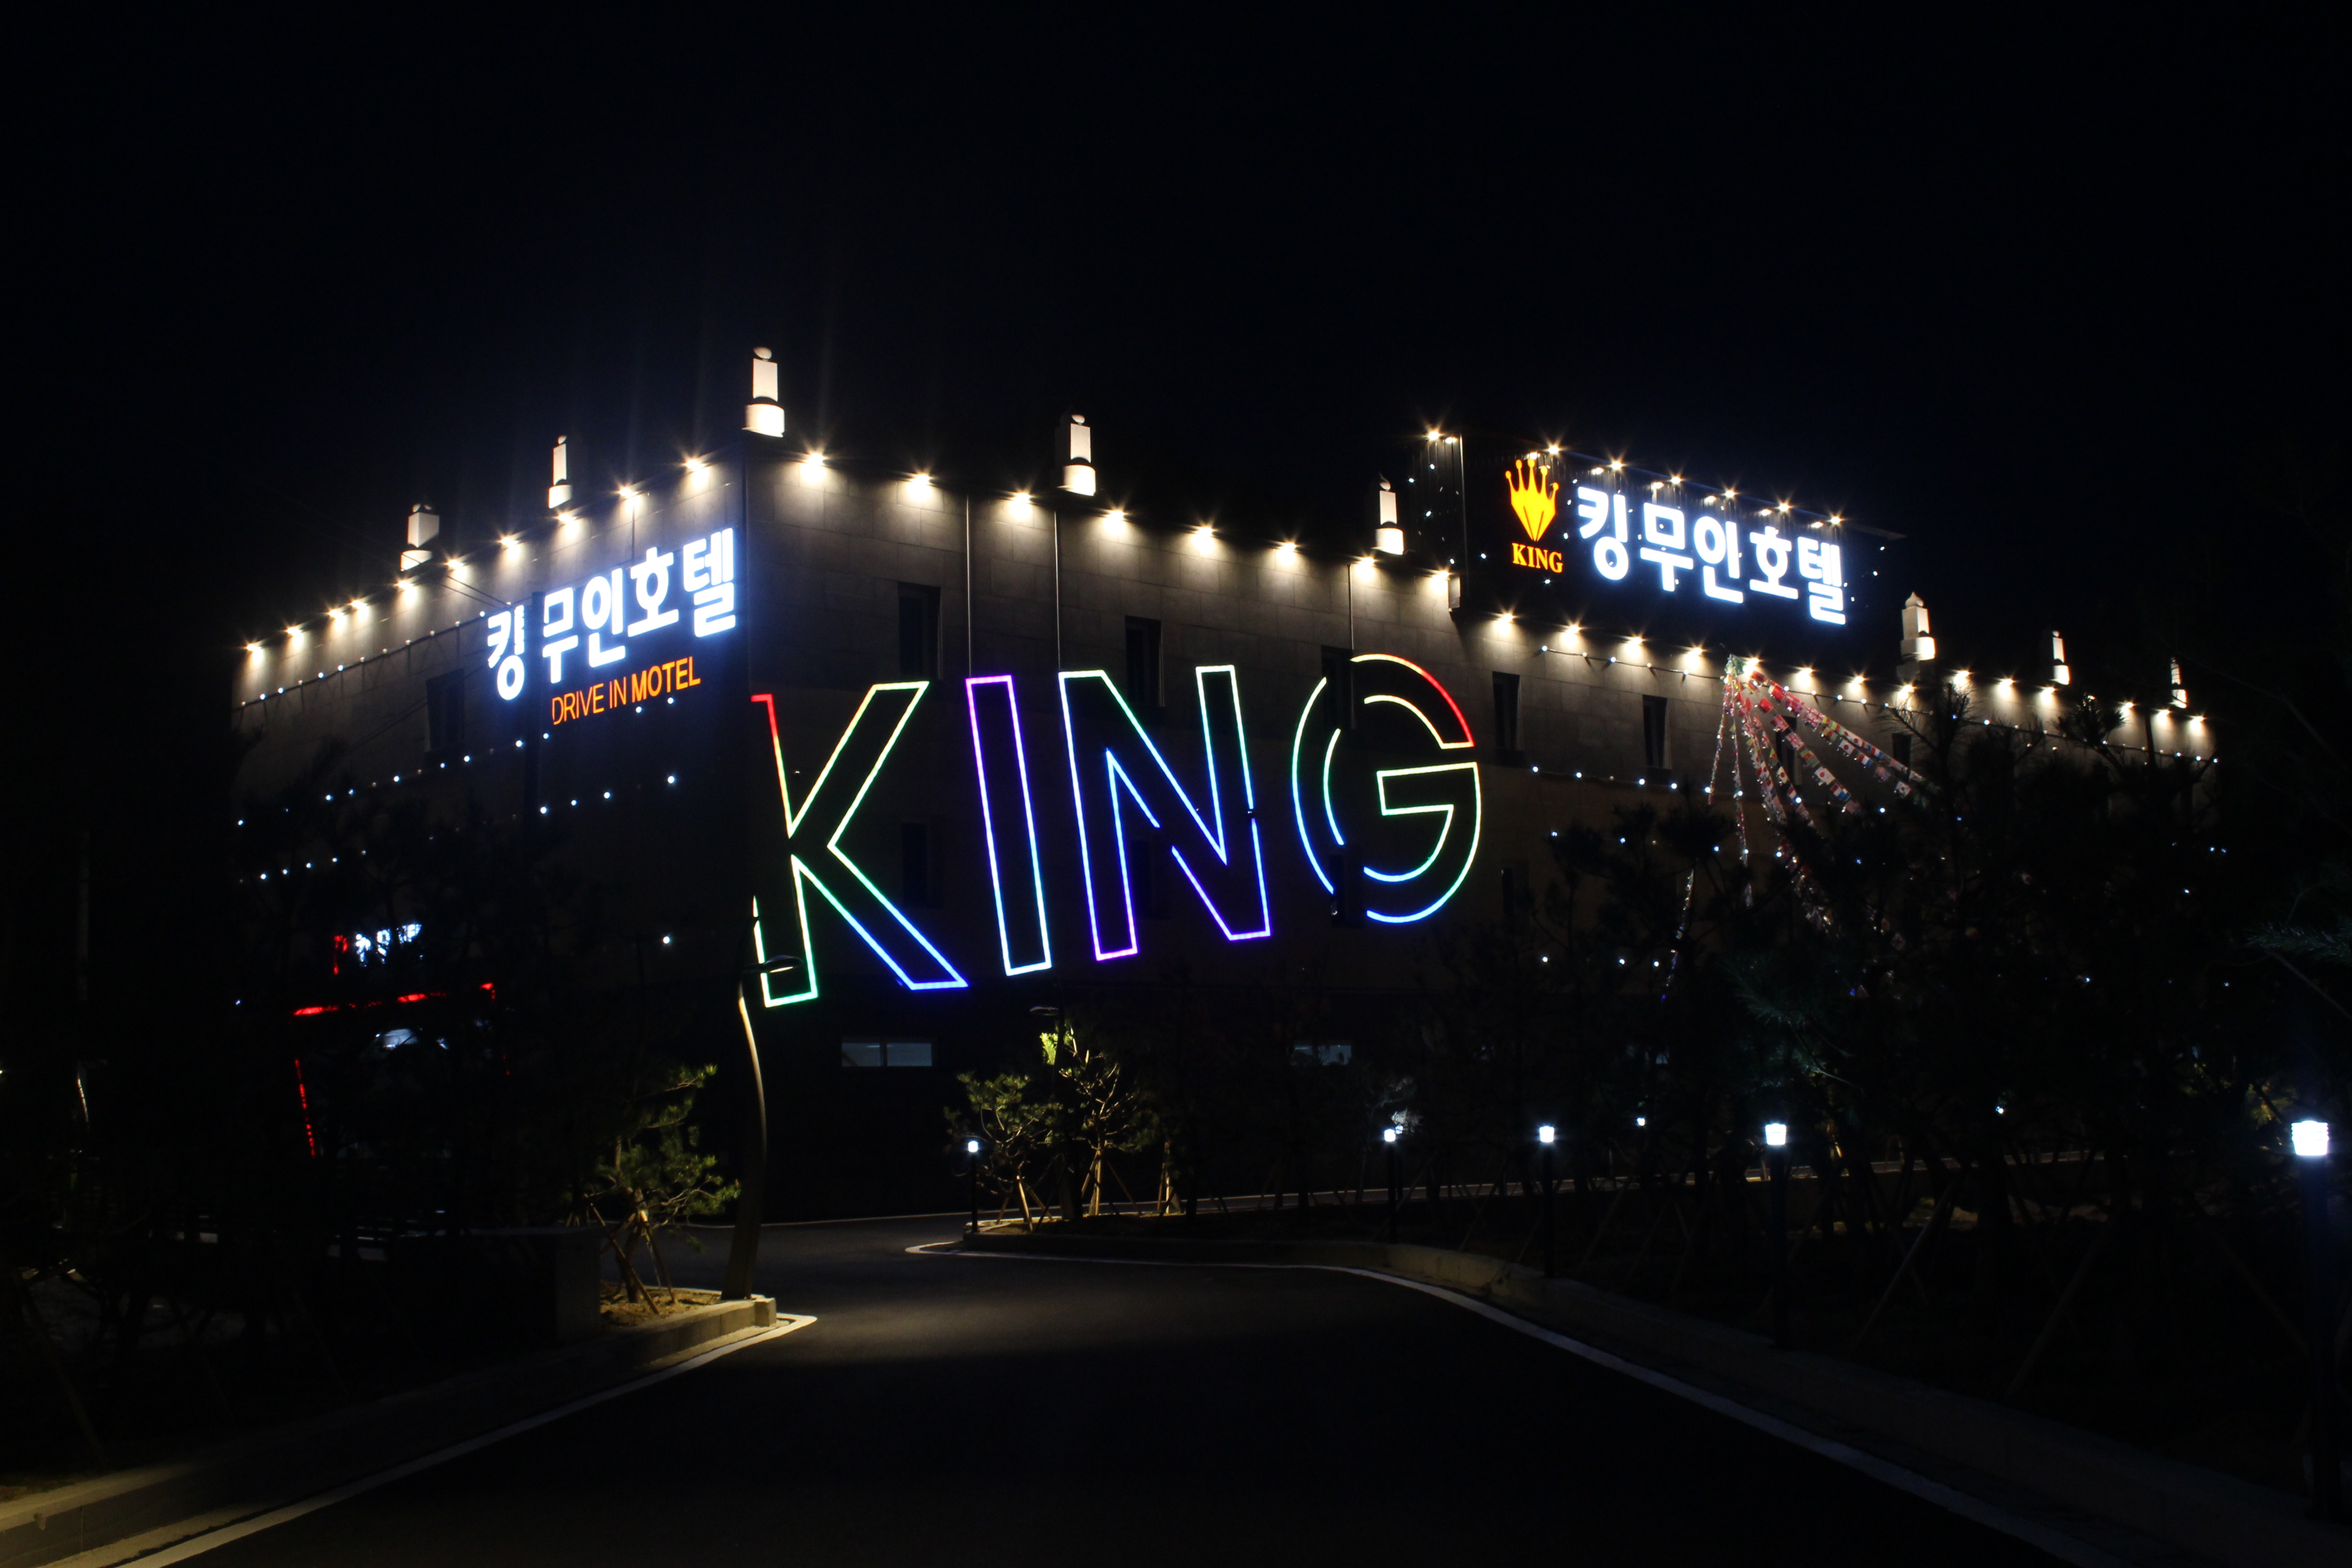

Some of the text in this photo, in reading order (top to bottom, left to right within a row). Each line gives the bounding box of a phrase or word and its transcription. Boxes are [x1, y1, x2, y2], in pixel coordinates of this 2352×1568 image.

[1511, 542, 1564, 573] KING
[552, 656, 701, 725] DRIVE IN MOTEL
[750, 652, 1482, 1008] KING
